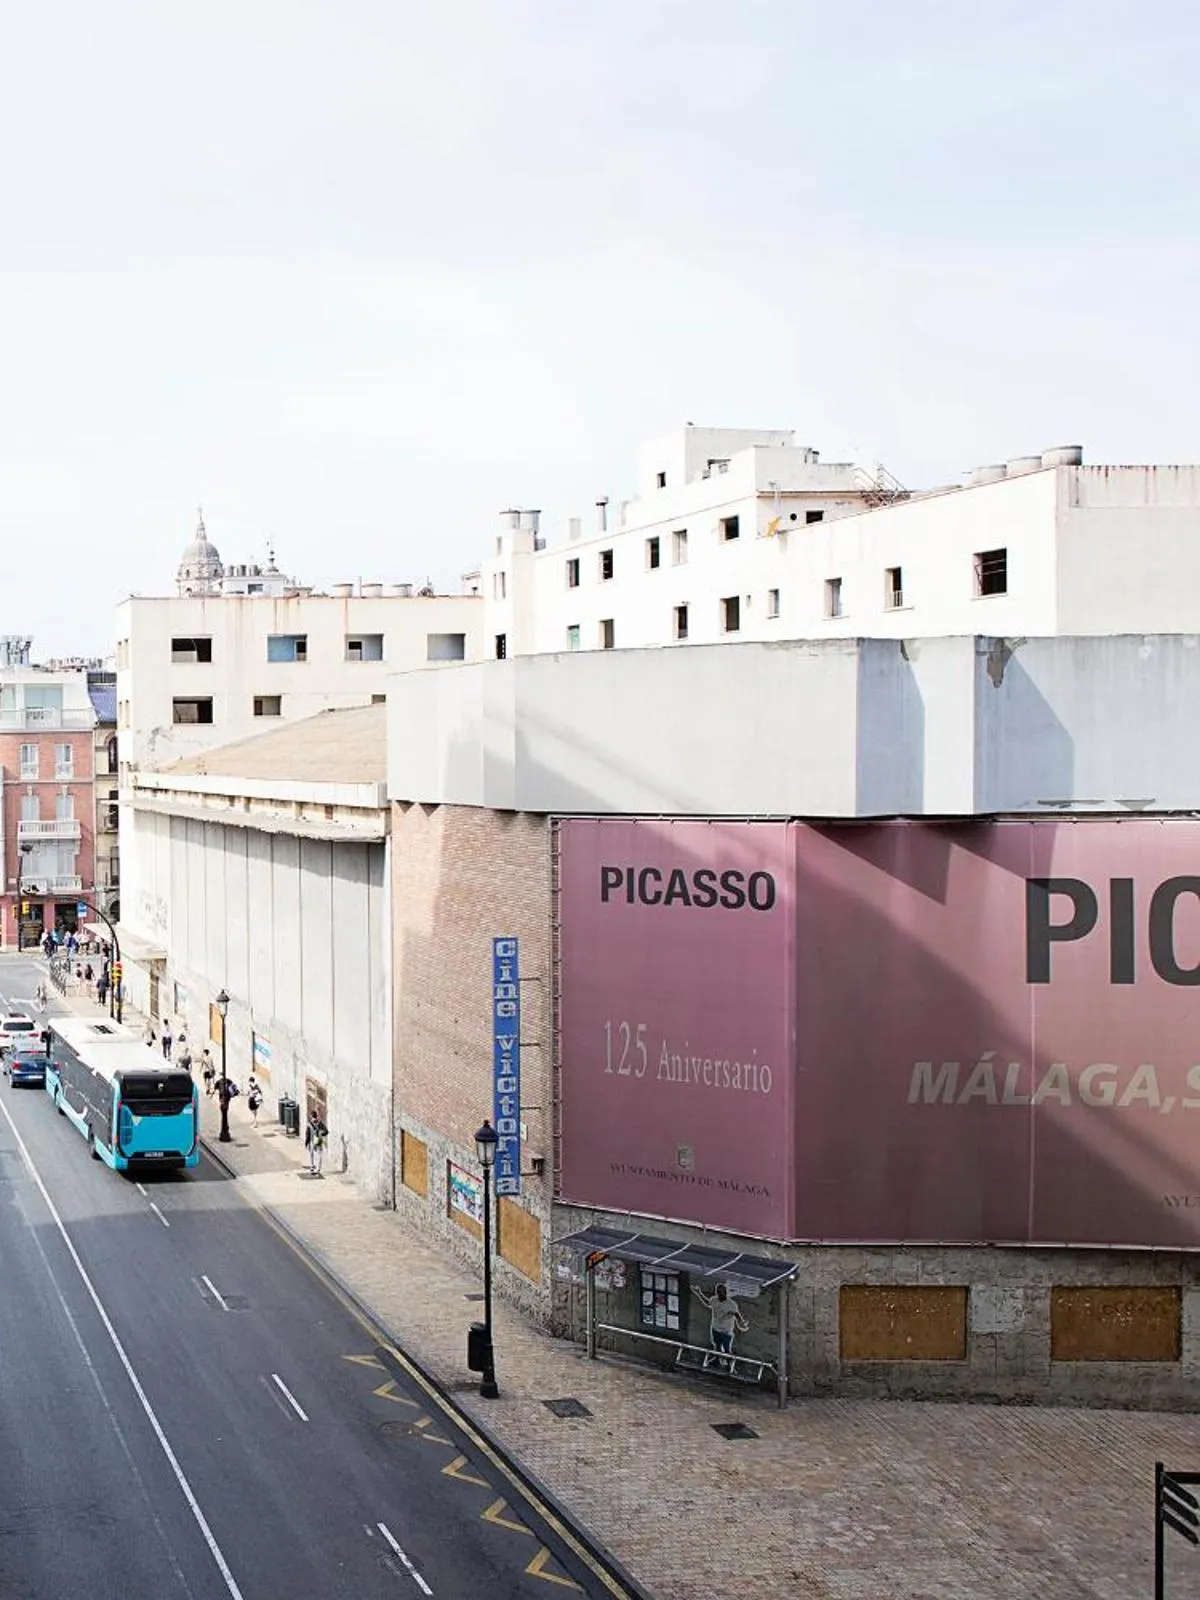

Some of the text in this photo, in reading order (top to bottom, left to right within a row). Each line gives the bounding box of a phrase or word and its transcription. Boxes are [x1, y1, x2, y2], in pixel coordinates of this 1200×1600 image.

[601, 866, 776, 911] PICASSO
[1026, 875, 1200, 986] PIC
[604, 1020, 772, 1093] 125 Aniversario
[610, 1163, 700, 1184] AYUNTAMIENTO
[699, 1175, 714, 1187] DE
